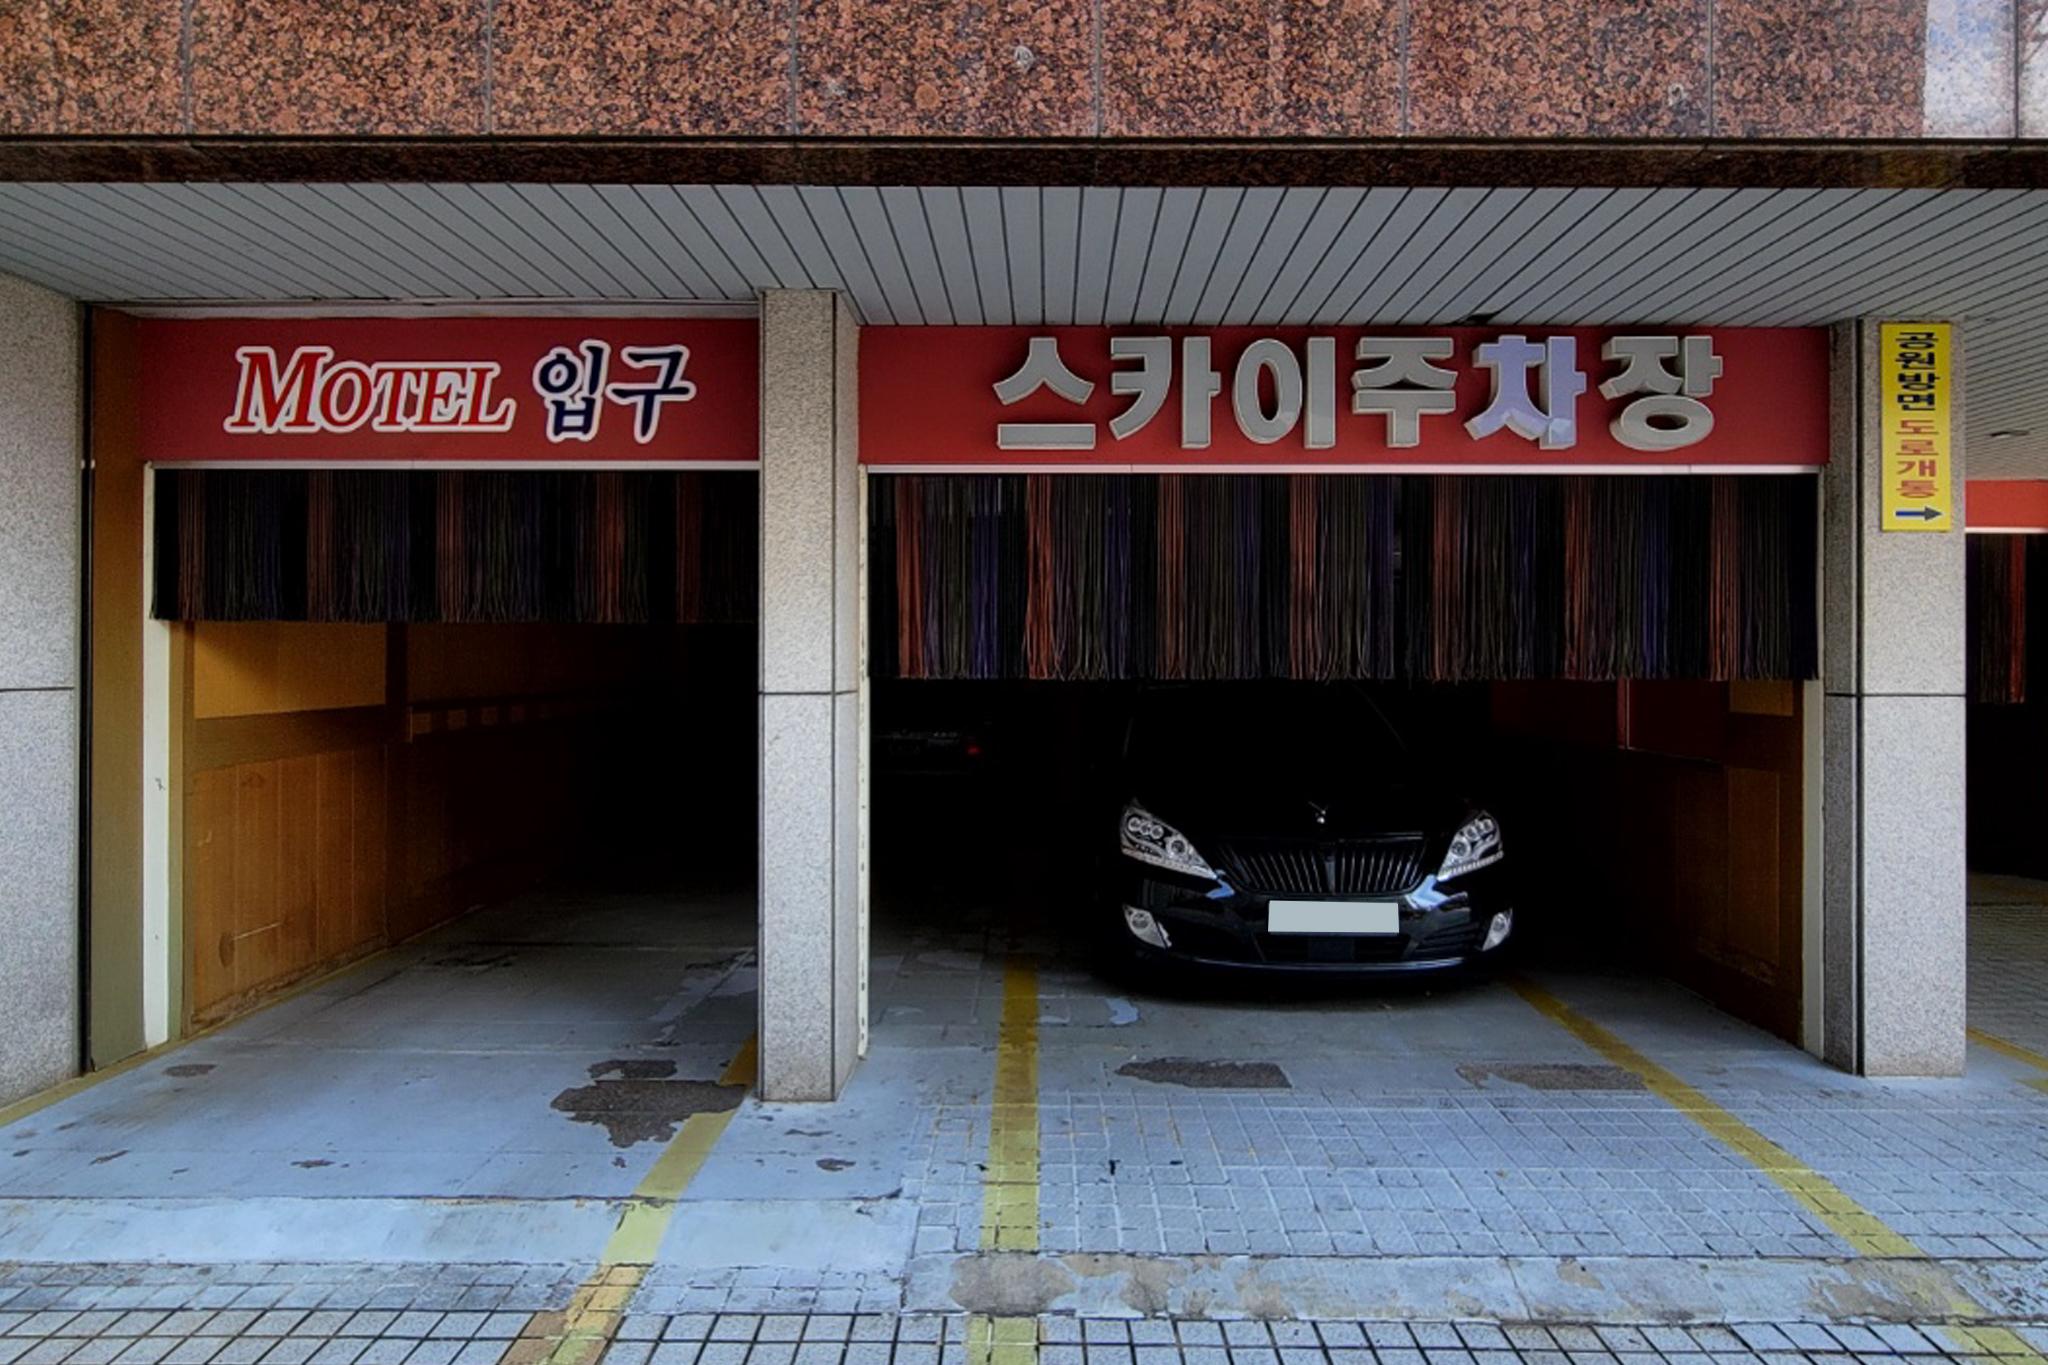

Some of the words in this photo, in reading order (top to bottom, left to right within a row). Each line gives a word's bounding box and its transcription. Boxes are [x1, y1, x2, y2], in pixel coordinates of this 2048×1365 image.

[224, 346, 517, 434] MOTEL
[533, 339, 696, 443] 입구
[1895, 419, 1940, 499] 도로개통
